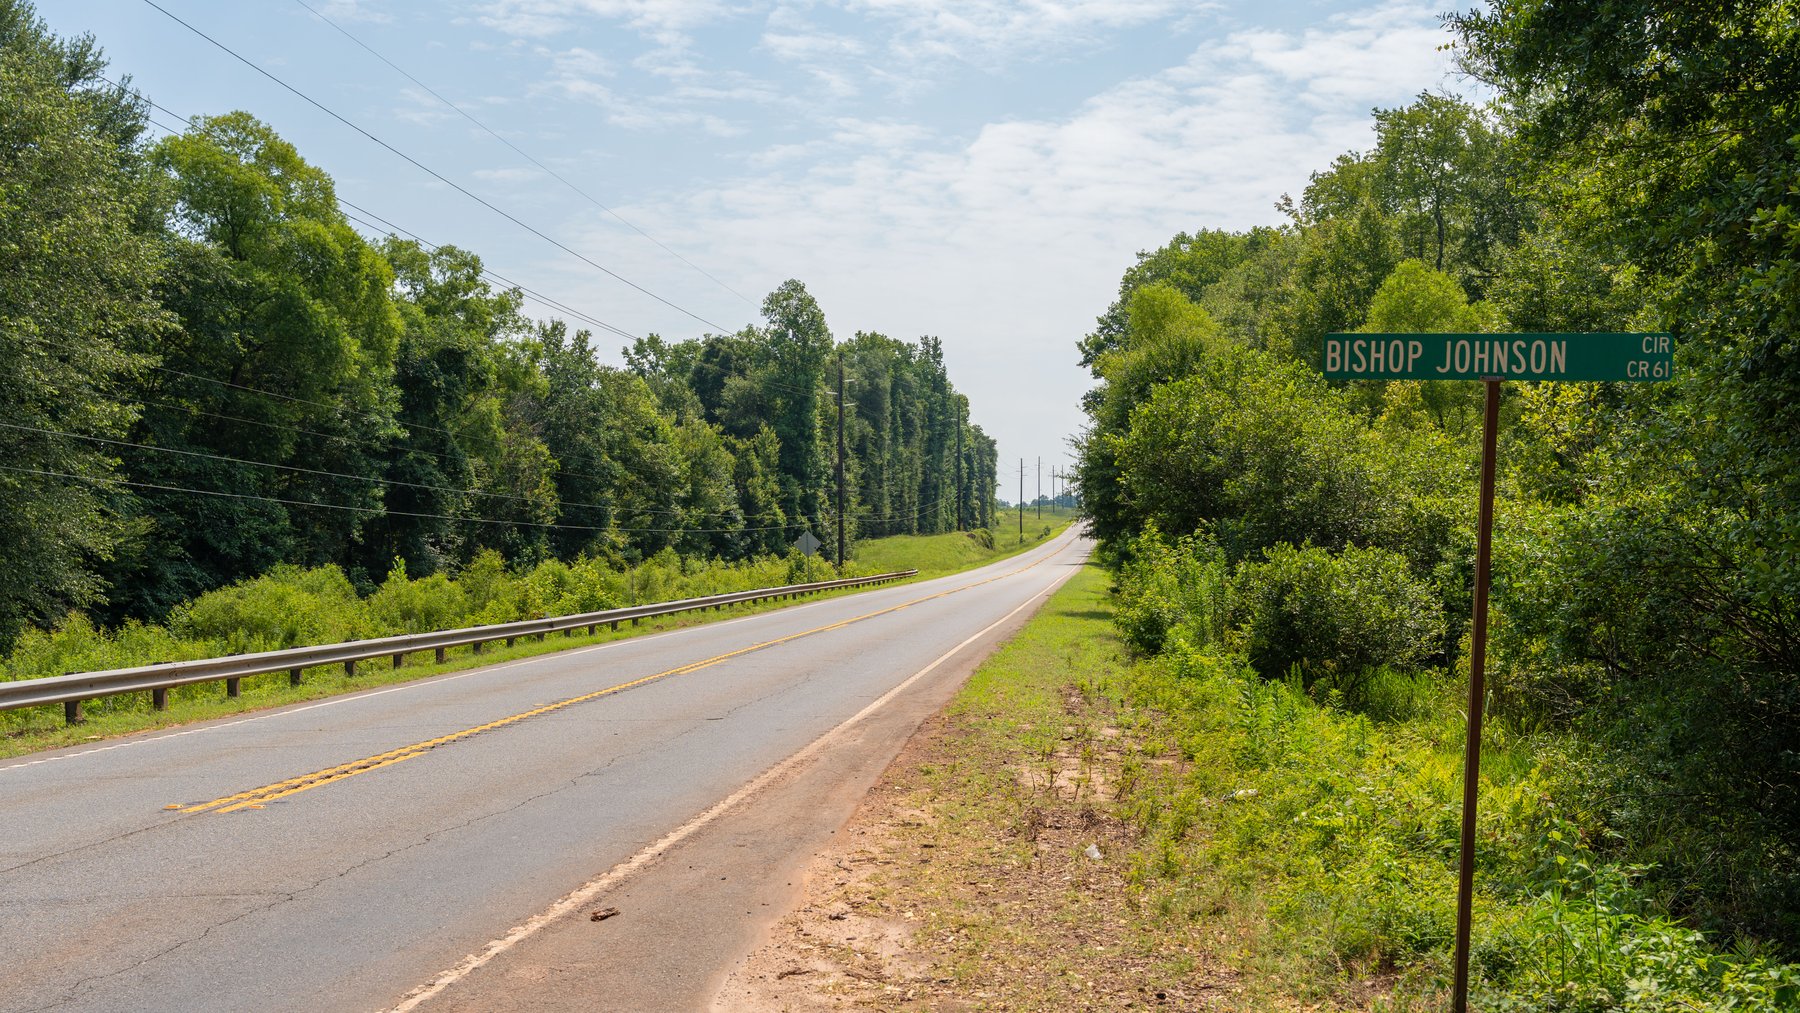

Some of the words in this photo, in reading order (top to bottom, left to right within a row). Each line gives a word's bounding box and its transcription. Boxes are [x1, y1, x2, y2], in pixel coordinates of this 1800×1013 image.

[1326, 340, 1423, 373] BISHOP
[1436, 339, 1566, 373] JOHNSON
[1642, 336, 1669, 353] CIR
